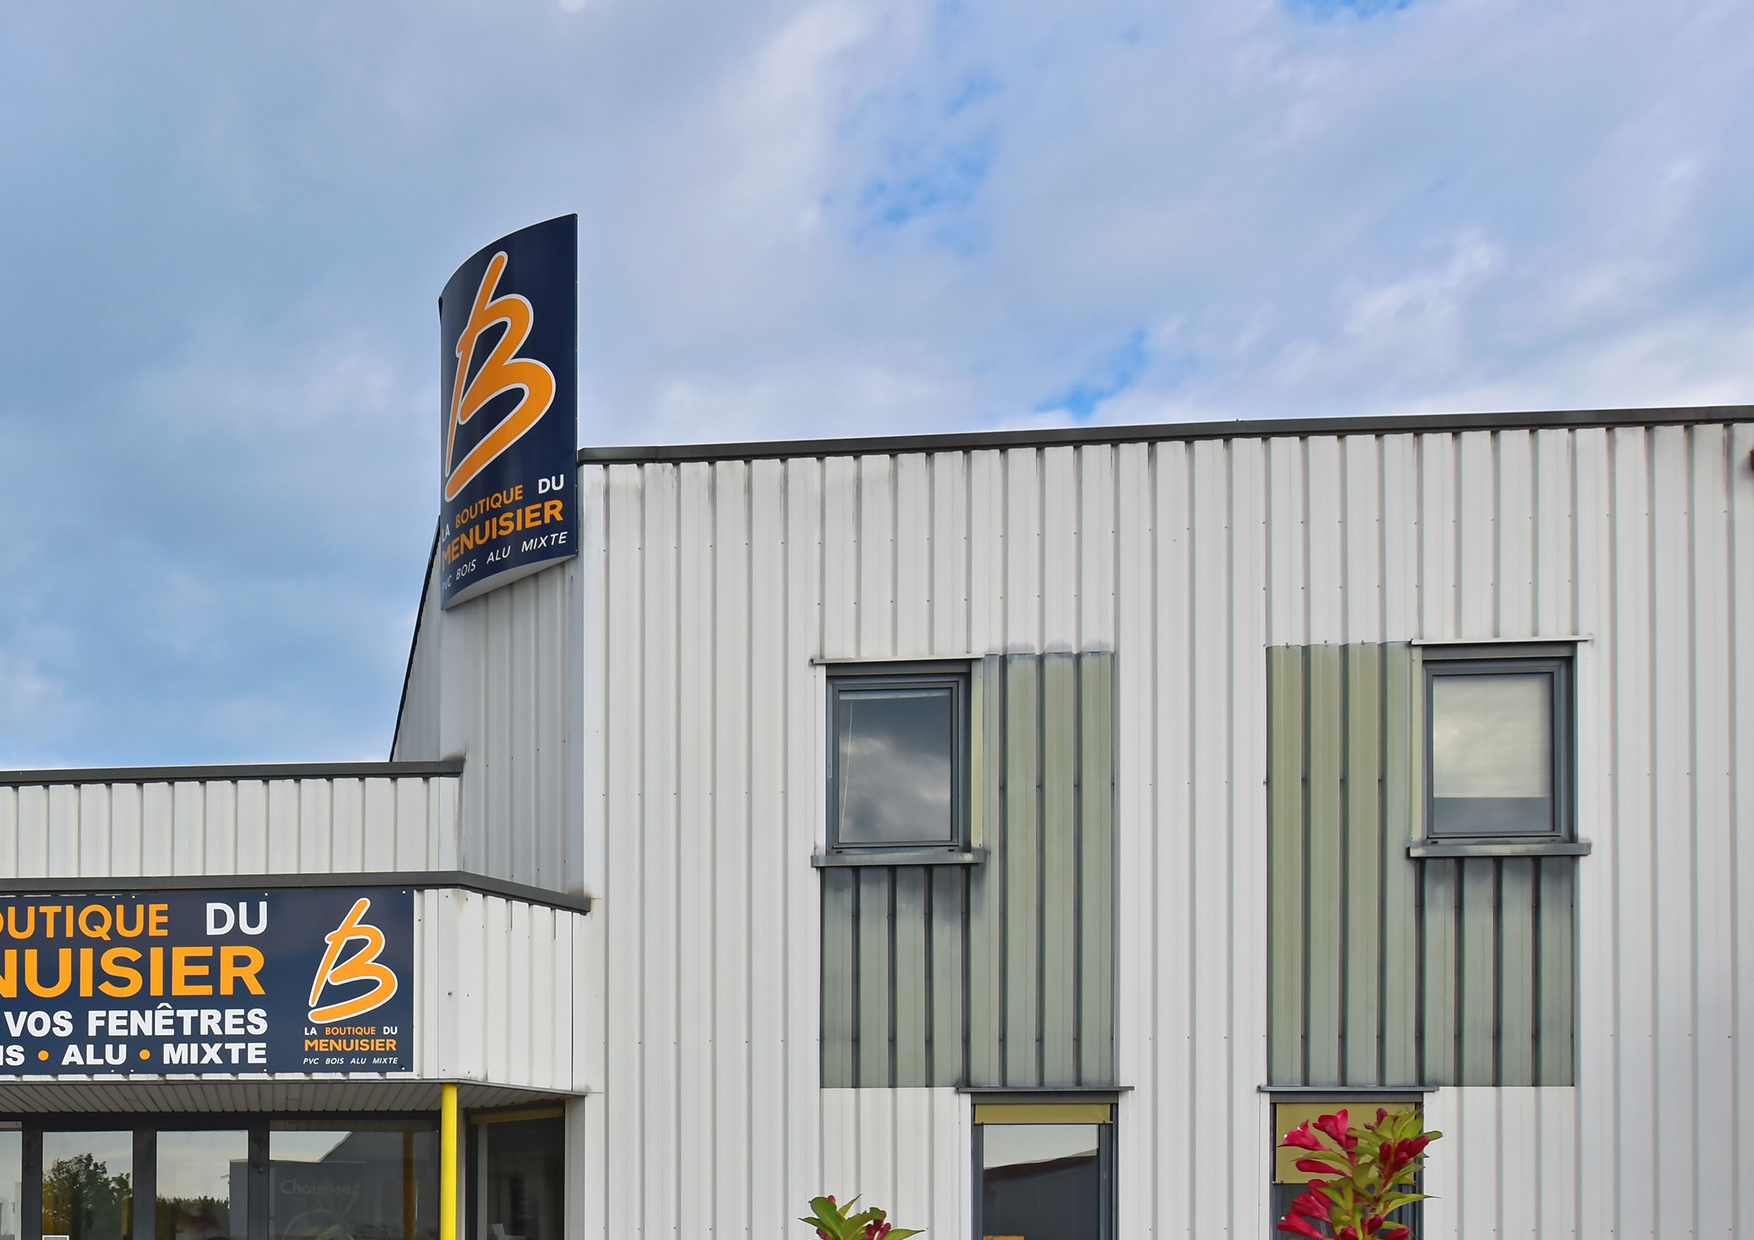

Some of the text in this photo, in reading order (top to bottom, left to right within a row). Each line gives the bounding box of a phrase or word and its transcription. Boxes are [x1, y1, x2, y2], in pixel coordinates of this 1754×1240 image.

[442, 474, 565, 543] LA BOUTIQUE DU
[442, 499, 564, 572] MENUISIER
[455, 559, 477, 581] BOIS
[486, 545, 511, 565] ALU
[521, 531, 568, 553] MIXTE
[206, 902, 268, 936] DU
[4, 1010, 73, 1037] VOS
[88, 1003, 268, 1036] FENÊTRES
[304, 1026, 398, 1036] LA BOUTIQUE DU
[61, 1044, 127, 1065] ALU
[163, 1042, 267, 1064] MIXTE
[304, 1038, 397, 1051] MENUISIER
